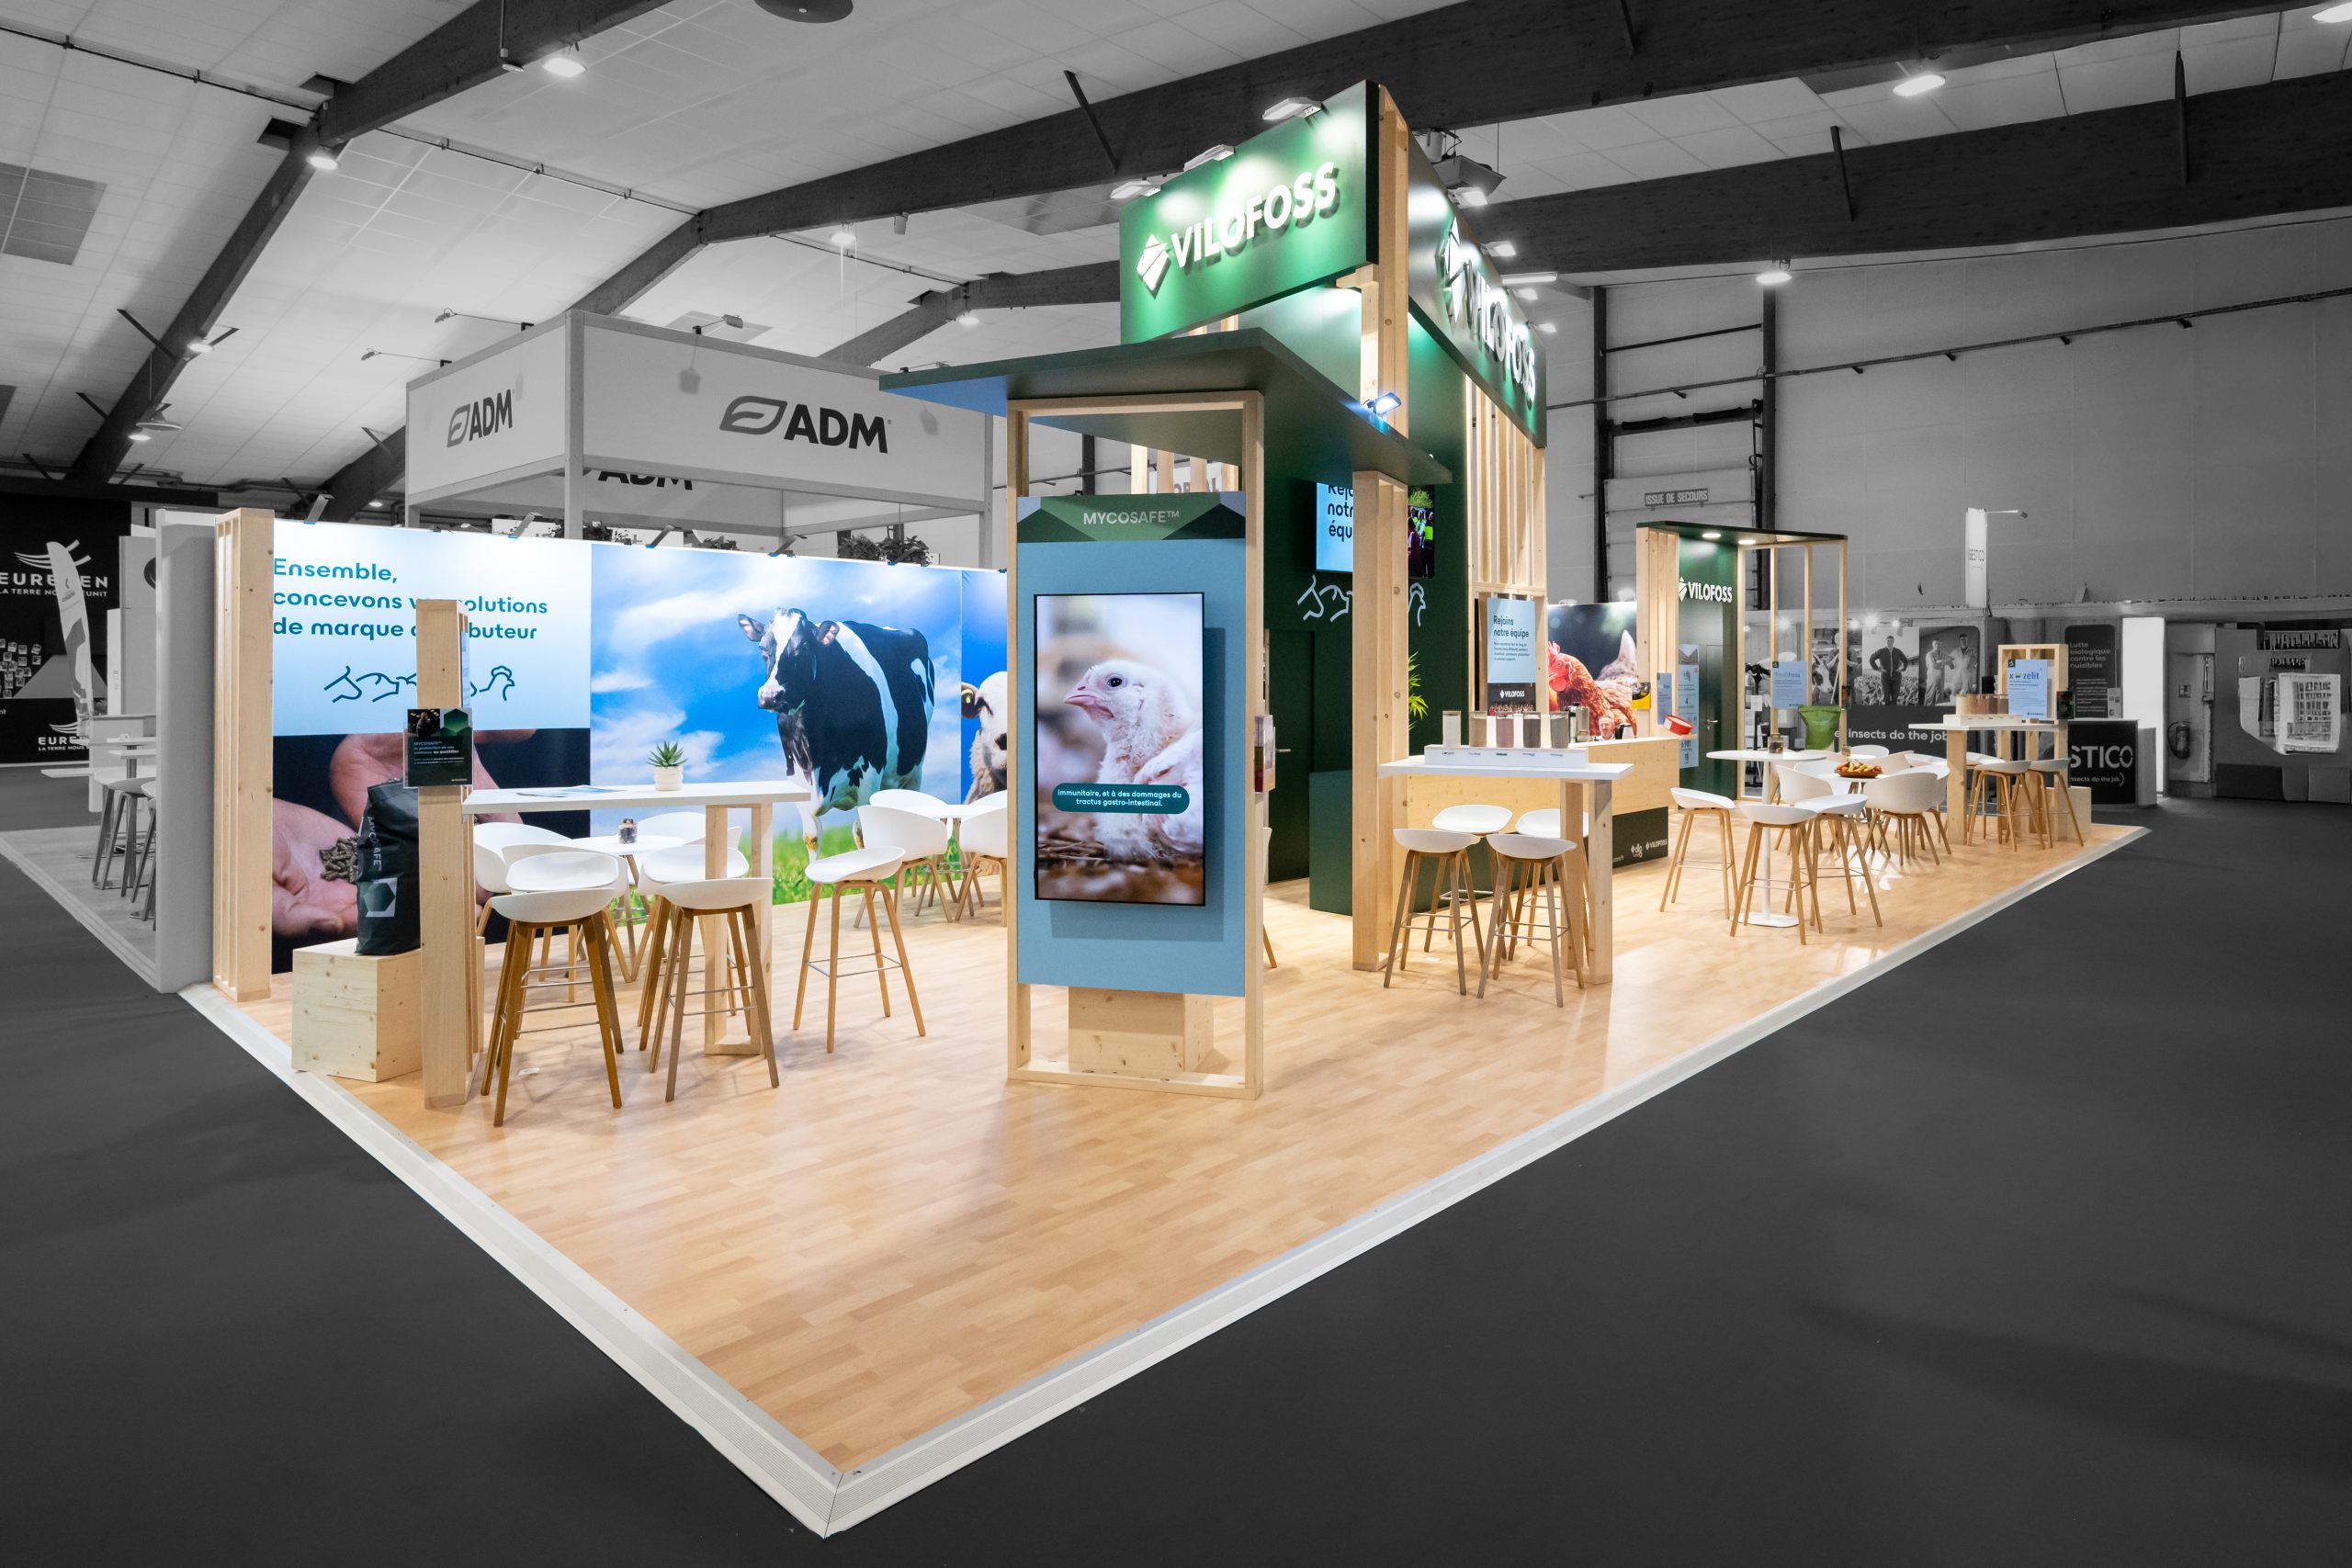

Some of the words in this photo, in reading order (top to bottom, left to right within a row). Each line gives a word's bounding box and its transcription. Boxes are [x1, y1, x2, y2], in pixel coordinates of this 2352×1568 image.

[1170, 162, 1337, 268] VILOFOSS
[469, 389, 513, 441] ADM
[784, 403, 888, 454] ADM
[1645, 494, 1664, 505] ISSUE
[1666, 492, 1675, 503] DE
[1677, 490, 1708, 502] SECOURS
[1328, 502, 1353, 518] notr
[274, 558, 397, 583] Ensemble,
[0, 571, 108, 588] EUREEN
[1687, 581, 1733, 604] VILOFOSS
[274, 592, 402, 609] concevons
[458, 595, 548, 615] olutions
[274, 616, 303, 635] de
[311, 622, 403, 641] marque
[1493, 615, 1514, 626] Rejoins
[1493, 628, 1511, 637] notre
[1510, 628, 1530, 640] équipe
[1504, 690, 1525, 698] VILOFOSS
[1848, 728, 1887, 739] insects
[1889, 729, 1905, 740] do
[1908, 730, 1928, 740] the
[2071, 745, 2133, 768] STICO
[1102, 799, 1163, 807] gastro-intestinal.
[1132, 791, 1170, 799] dommages
